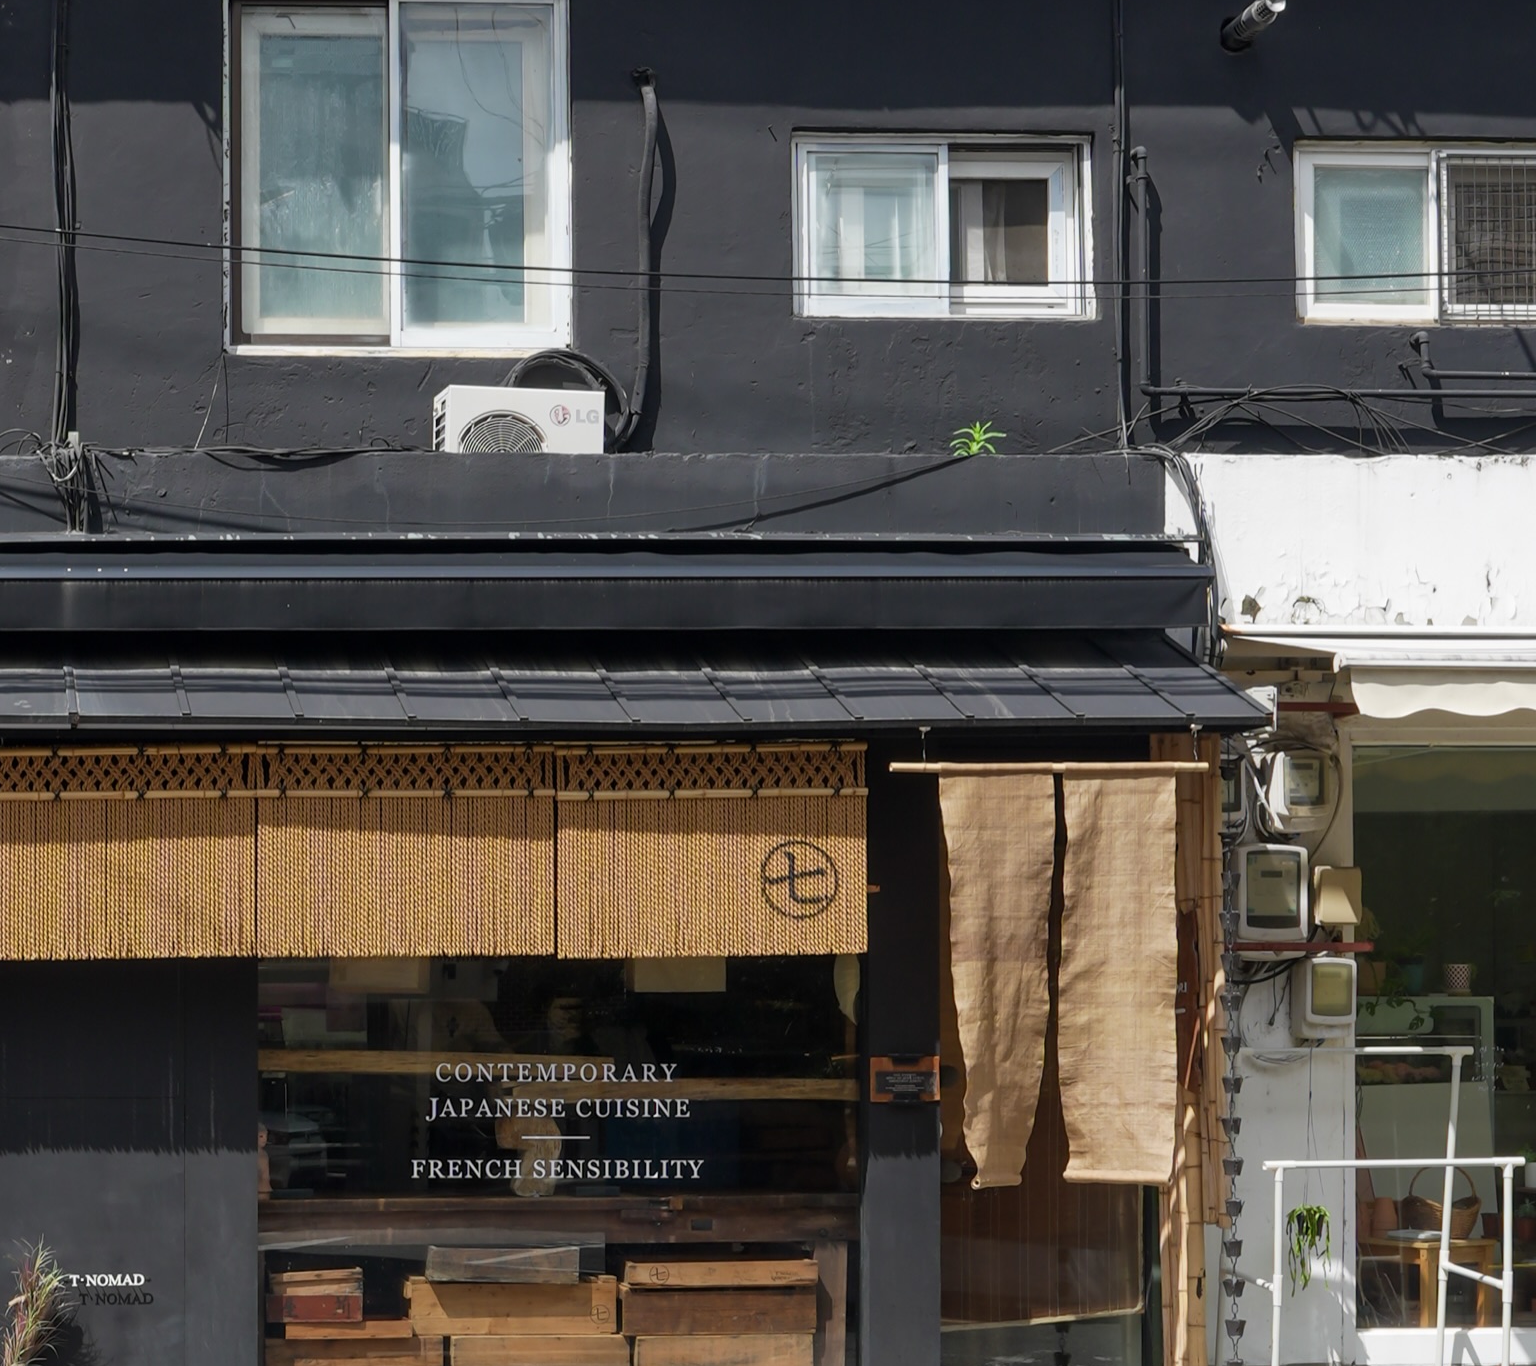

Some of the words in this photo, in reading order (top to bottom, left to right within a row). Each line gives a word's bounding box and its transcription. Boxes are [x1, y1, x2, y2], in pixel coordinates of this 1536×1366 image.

[575, 409, 600, 424] LG
[435, 1063, 678, 1083] CONTEMPORARY
[425, 1097, 565, 1121] JAPANESE
[575, 1098, 691, 1118] CUISINE
[410, 1159, 523, 1179] FRENCH
[532, 1158, 705, 1179] SENSIBILITY
